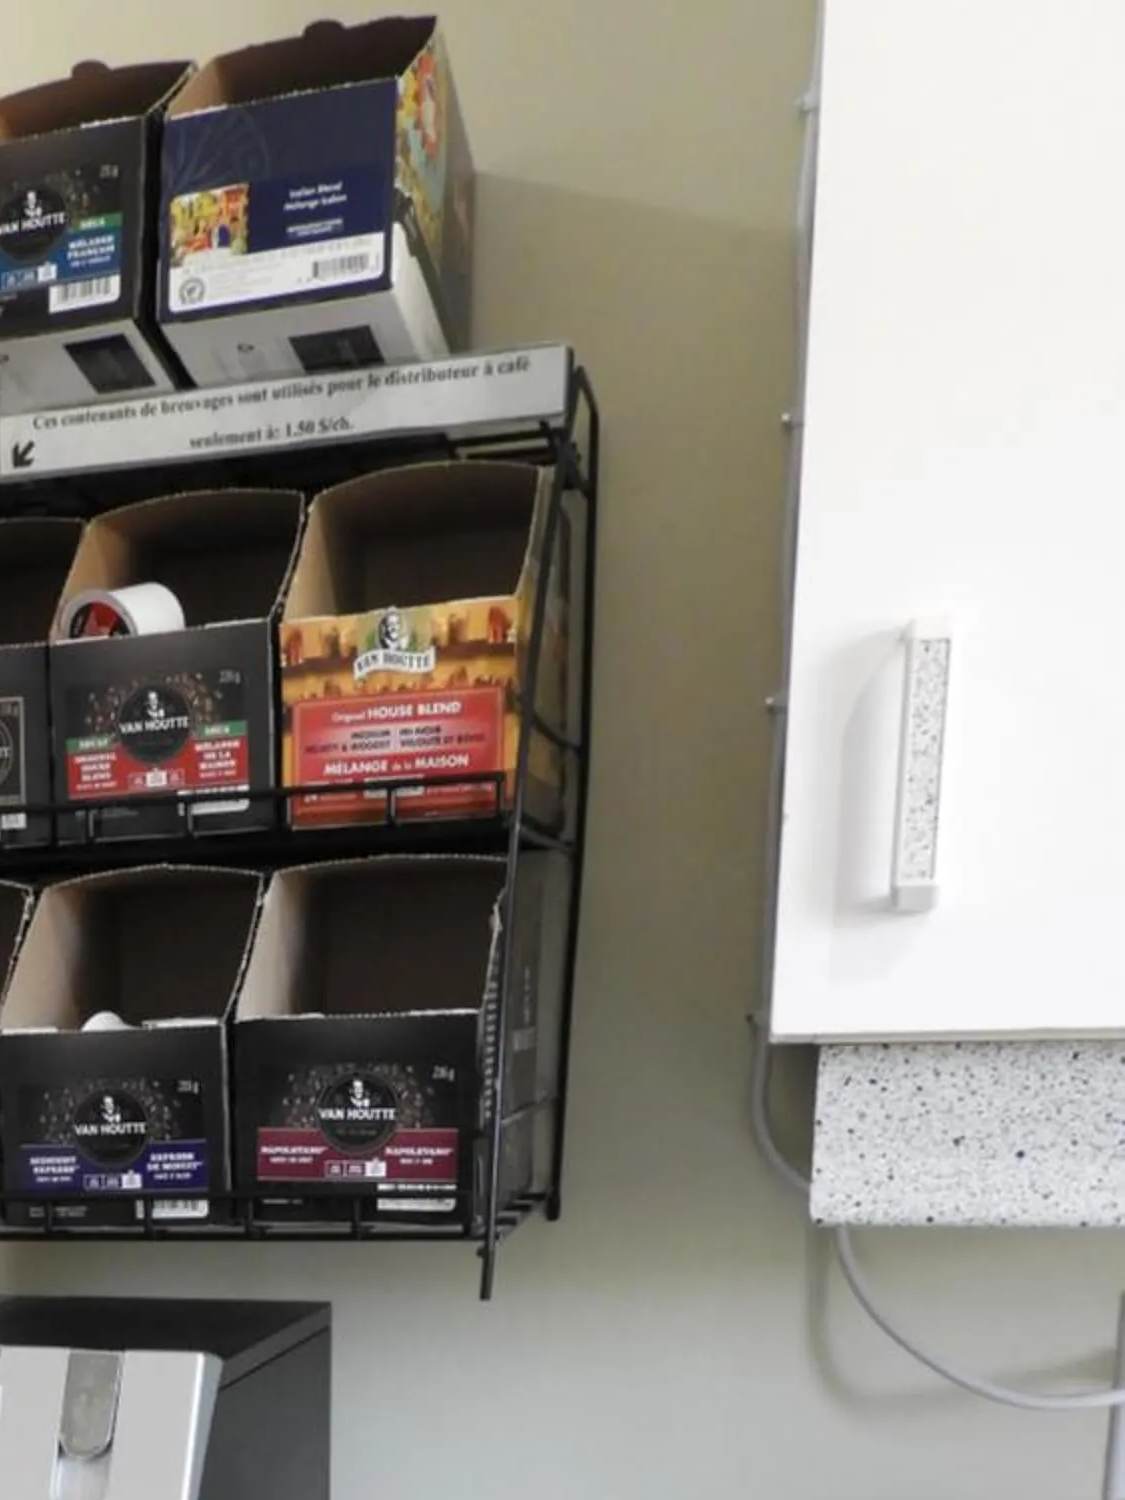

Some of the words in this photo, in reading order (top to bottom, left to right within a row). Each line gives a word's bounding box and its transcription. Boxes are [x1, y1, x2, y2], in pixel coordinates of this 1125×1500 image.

[33, 415, 58, 431] Ces
[61, 405, 137, 426] contenants
[140, 401, 159, 418] de
[161, 394, 234, 414] breuvages
[237, 388, 268, 404] sont
[272, 382, 323, 400] utilisés
[327, 377, 363, 397] pour
[366, 374, 383, 390] le
[385, 366, 478, 387] distributeur
[483, 359, 494, 376] à
[497, 355, 530, 374] café
[189, 428, 263, 449] seulement
[285, 420, 315, 437] 1.50
[367, 705, 415, 720] HOUSE
[416, 702, 462, 716] BLEND
[118, 721, 143, 735] VAN
[145, 715, 191, 731] HOUTTE
[415, 754, 470, 770] MAISON
[318, 1108, 345, 1120] VAN
[347, 1107, 396, 1121] HOUTTE
[74, 1123, 98, 1136] VAN
[100, 1121, 147, 1135] HOUTTE
